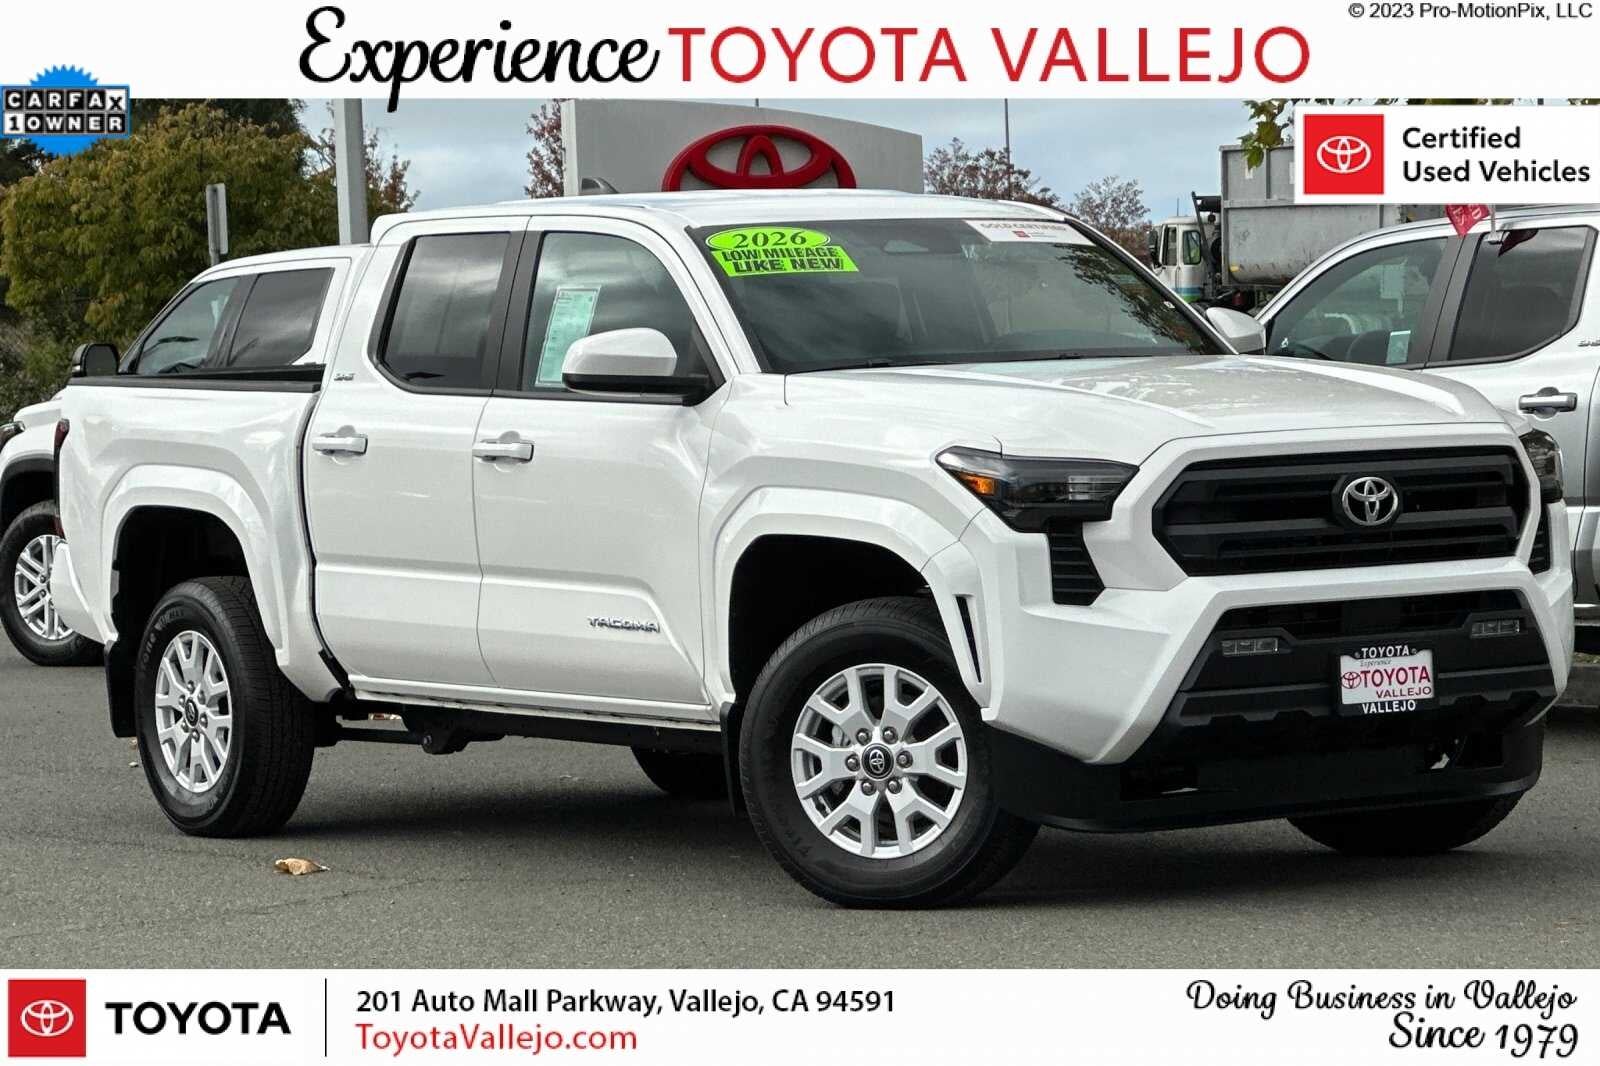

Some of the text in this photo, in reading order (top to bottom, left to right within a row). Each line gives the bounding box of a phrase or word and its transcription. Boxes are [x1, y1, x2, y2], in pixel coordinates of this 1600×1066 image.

[731, 231, 807, 249] 2026
[722, 247, 839, 262] LOW MILEAGE
[733, 257, 843, 273] LIKE NEW
[587, 617, 660, 633] TACOMA
[1361, 645, 1410, 659] TOYOTA
[1360, 665, 1431, 688] TOYOTA
[1376, 686, 1432, 699] VALLEJO
[1362, 700, 1416, 714] VALLEJO
